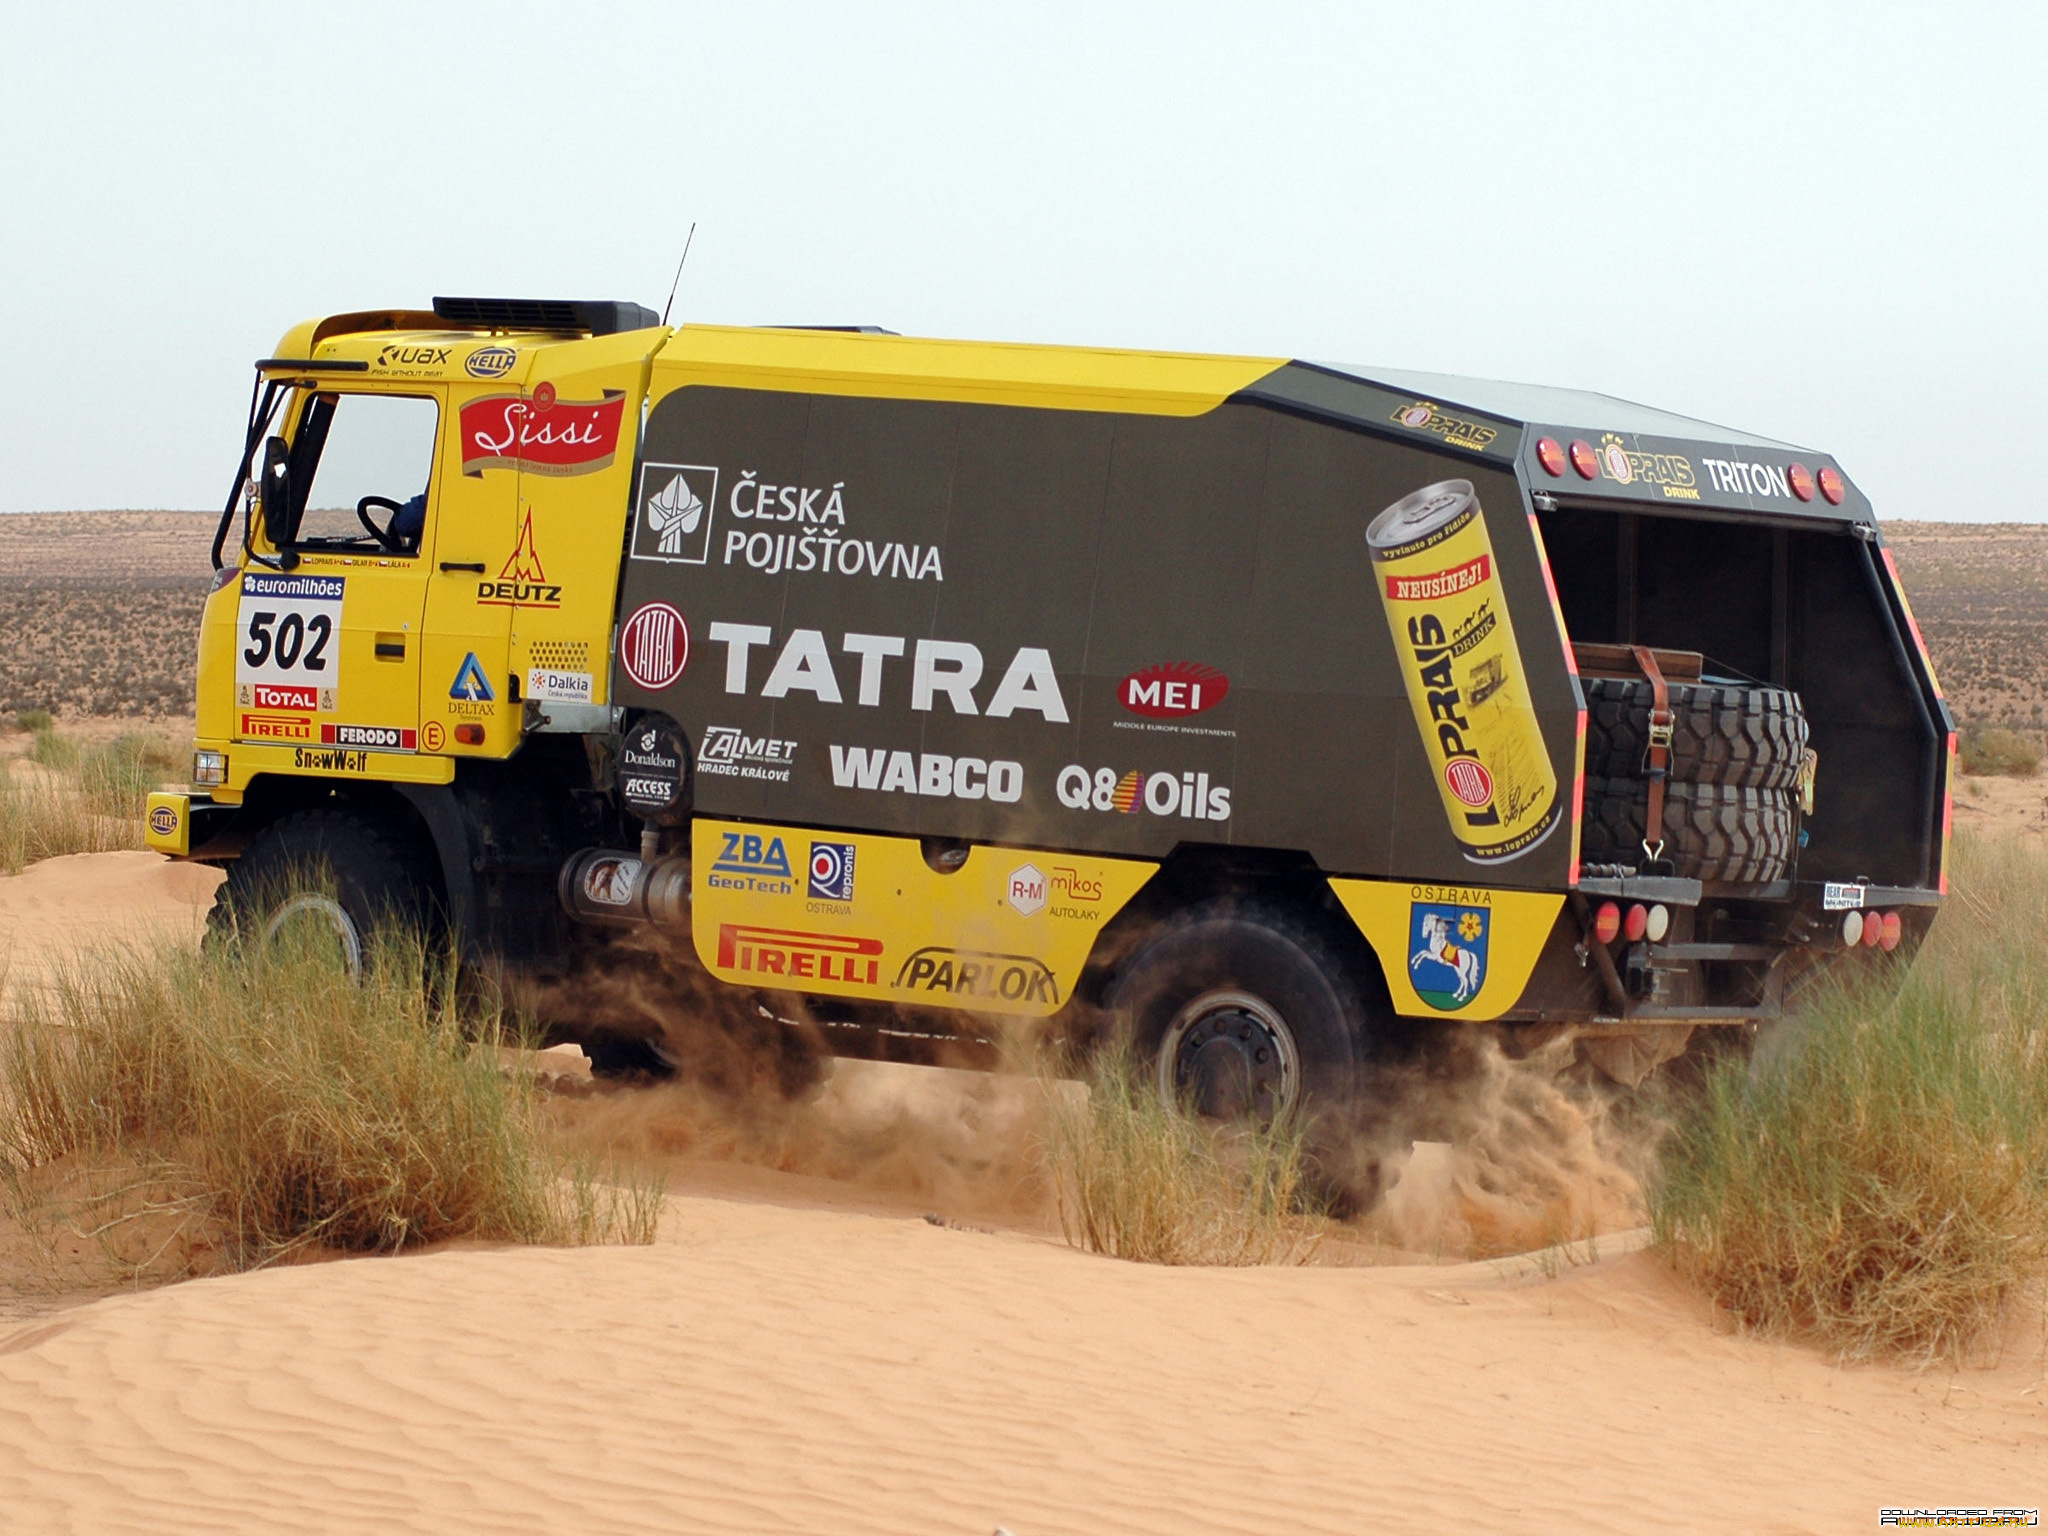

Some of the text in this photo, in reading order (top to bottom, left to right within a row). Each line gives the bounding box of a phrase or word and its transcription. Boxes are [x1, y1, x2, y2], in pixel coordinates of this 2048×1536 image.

[474, 402, 602, 457] Sissi
[1444, 435, 1486, 452] DRINK
[1702, 458, 1791, 498] TRITON
[730, 469, 846, 525] ČESKÁ
[1663, 485, 1700, 500] DRINK
[1427, 532, 1443, 546] pro
[724, 526, 944, 582] POJIŠŤOVNA
[256, 578, 343, 596] euromilhões
[1397, 562, 1482, 599] NEUSÍNEJ!
[477, 582, 562, 602] DEUTZ
[243, 611, 333, 671] 502
[633, 608, 676, 682] TATRA
[1453, 617, 1494, 657] DRINK
[548, 674, 589, 692] Dalkia
[709, 621, 1070, 724] TATRA
[256, 687, 316, 708] TOTAL
[1128, 678, 1201, 711] MEI
[448, 702, 495, 716] DELTAX
[241, 713, 311, 738] PIRELLI
[428, 727, 439, 745] E
[1112, 721, 1237, 737] MIDDLE EUROPE INVESTMENTS
[339, 728, 398, 745] FERODO
[625, 750, 676, 768] Donaldson
[697, 762, 791, 782] HRADEC KRÁLOVÉ
[829, 744, 1024, 803] WABCO
[625, 778, 672, 796] ACCESS
[714, 832, 790, 868] ZBA
[841, 845, 855, 900] repronis
[708, 873, 792, 894] GeoTech
[1012, 880, 1043, 901] R-M
[1411, 885, 1492, 904] OSTRAVA
[806, 901, 852, 915] OSTRAVA
[1050, 906, 1100, 922] AUTOLAKY
[717, 923, 884, 985] PIRELLI
[906, 957, 1056, 1004] PARLOK
